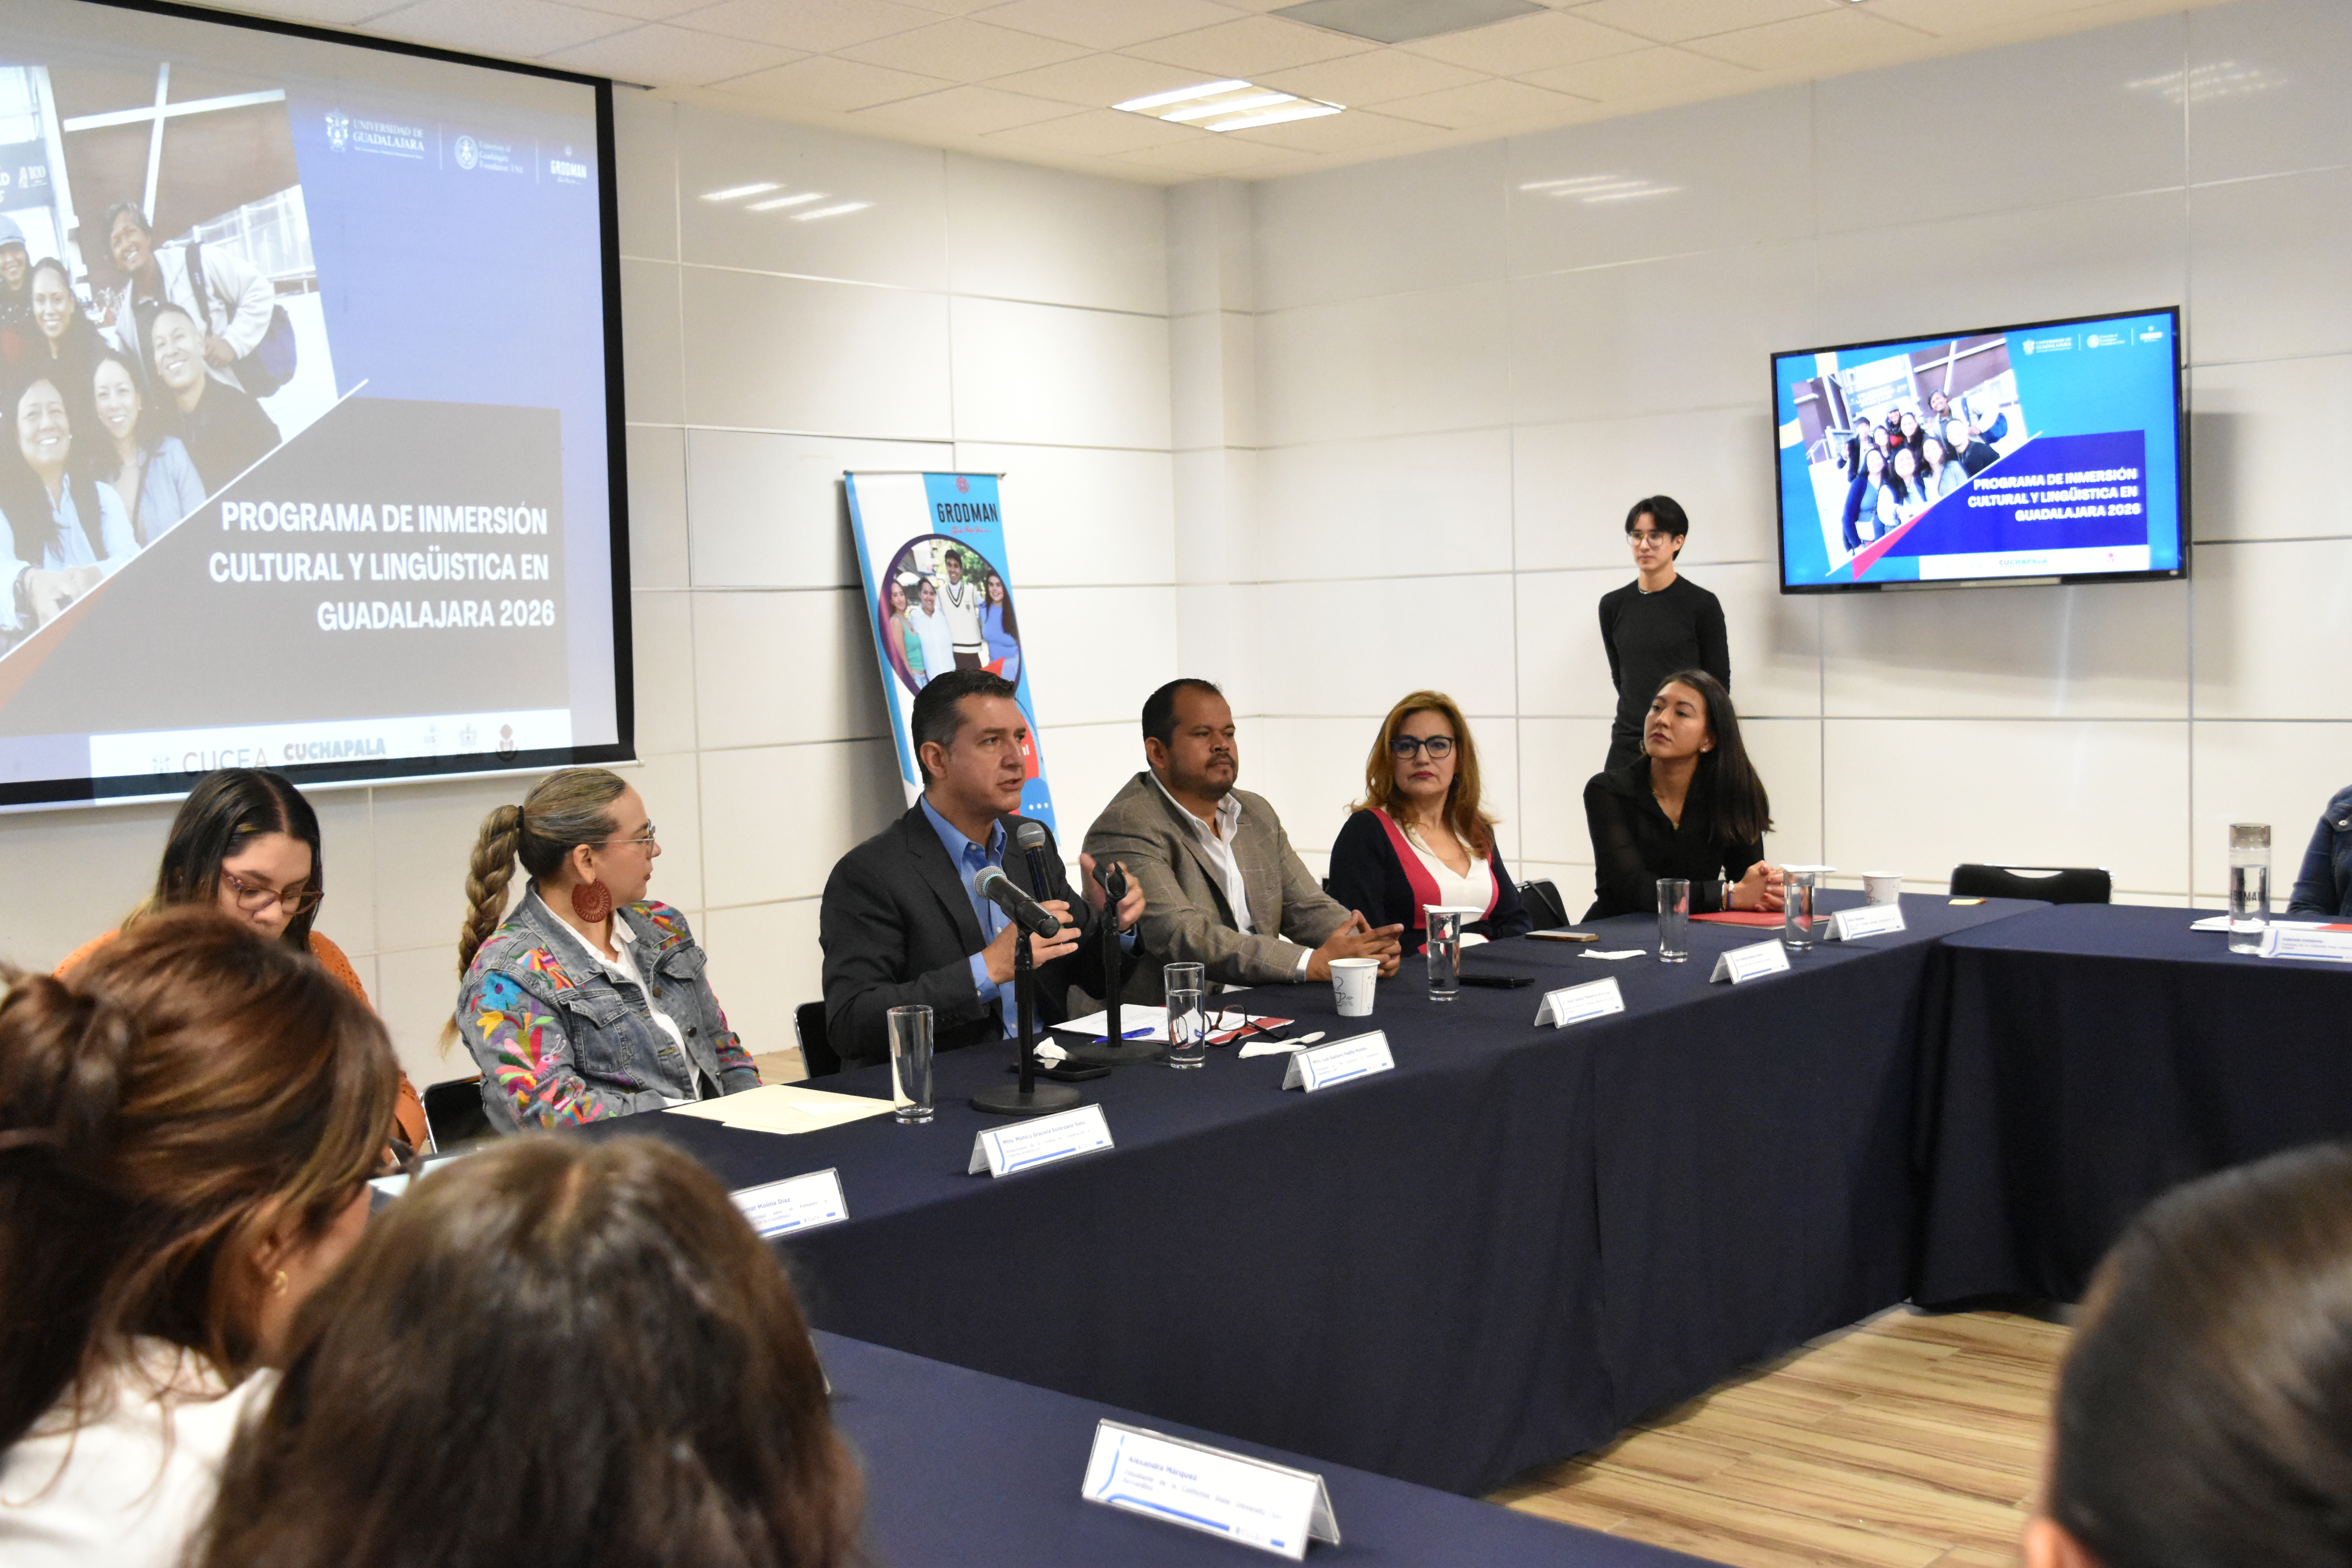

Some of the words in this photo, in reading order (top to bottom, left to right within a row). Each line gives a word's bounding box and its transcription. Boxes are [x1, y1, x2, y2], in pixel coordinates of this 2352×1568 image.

[353, 131, 424, 151] GUADALAJARA
[1974, 475, 2045, 490] PROGRAMA
[2047, 473, 2063, 486] DE
[2065, 466, 2137, 484] INMERSIÓN
[1968, 493, 2029, 508] CULTURAL
[2030, 492, 2039, 503] Y
[2041, 487, 2118, 503] LINGÜISTICA
[2120, 486, 2137, 498] EN
[222, 501, 377, 532] PROGRAMA
[383, 504, 414, 532] DE
[419, 501, 547, 534] INMERSIÓN
[937, 503, 998, 523] GRODMAN
[2015, 505, 2106, 521] GUADALAJARA
[2108, 503, 2141, 516] 2026
[209, 552, 343, 583] CULTURAL
[348, 553, 364, 581] Y
[370, 545, 516, 581] LINGÜISTICA
[521, 554, 548, 580] EN
[1999, 558, 2047, 566] CUCHAPALA
[318, 600, 495, 630] GUADALAJARA
[500, 600, 555, 627] 2026
[283, 738, 387, 761] CUCHAPALA
[1033, 1129, 1051, 1138] Graciela
[1052, 1124, 1074, 1132] Solórzano
[1006, 1145, 1027, 1154] Responsable
[1128, 1455, 1164, 1472] Alexandra
[1166, 1465, 1198, 1481] Márquez
[1122, 1477, 1153, 1491] Bernardino
[1124, 1468, 1154, 1483] Estudiante
[1181, 1485, 1210, 1499] California
[1215, 1495, 1230, 1504] State
[1236, 1501, 1266, 1515] University
